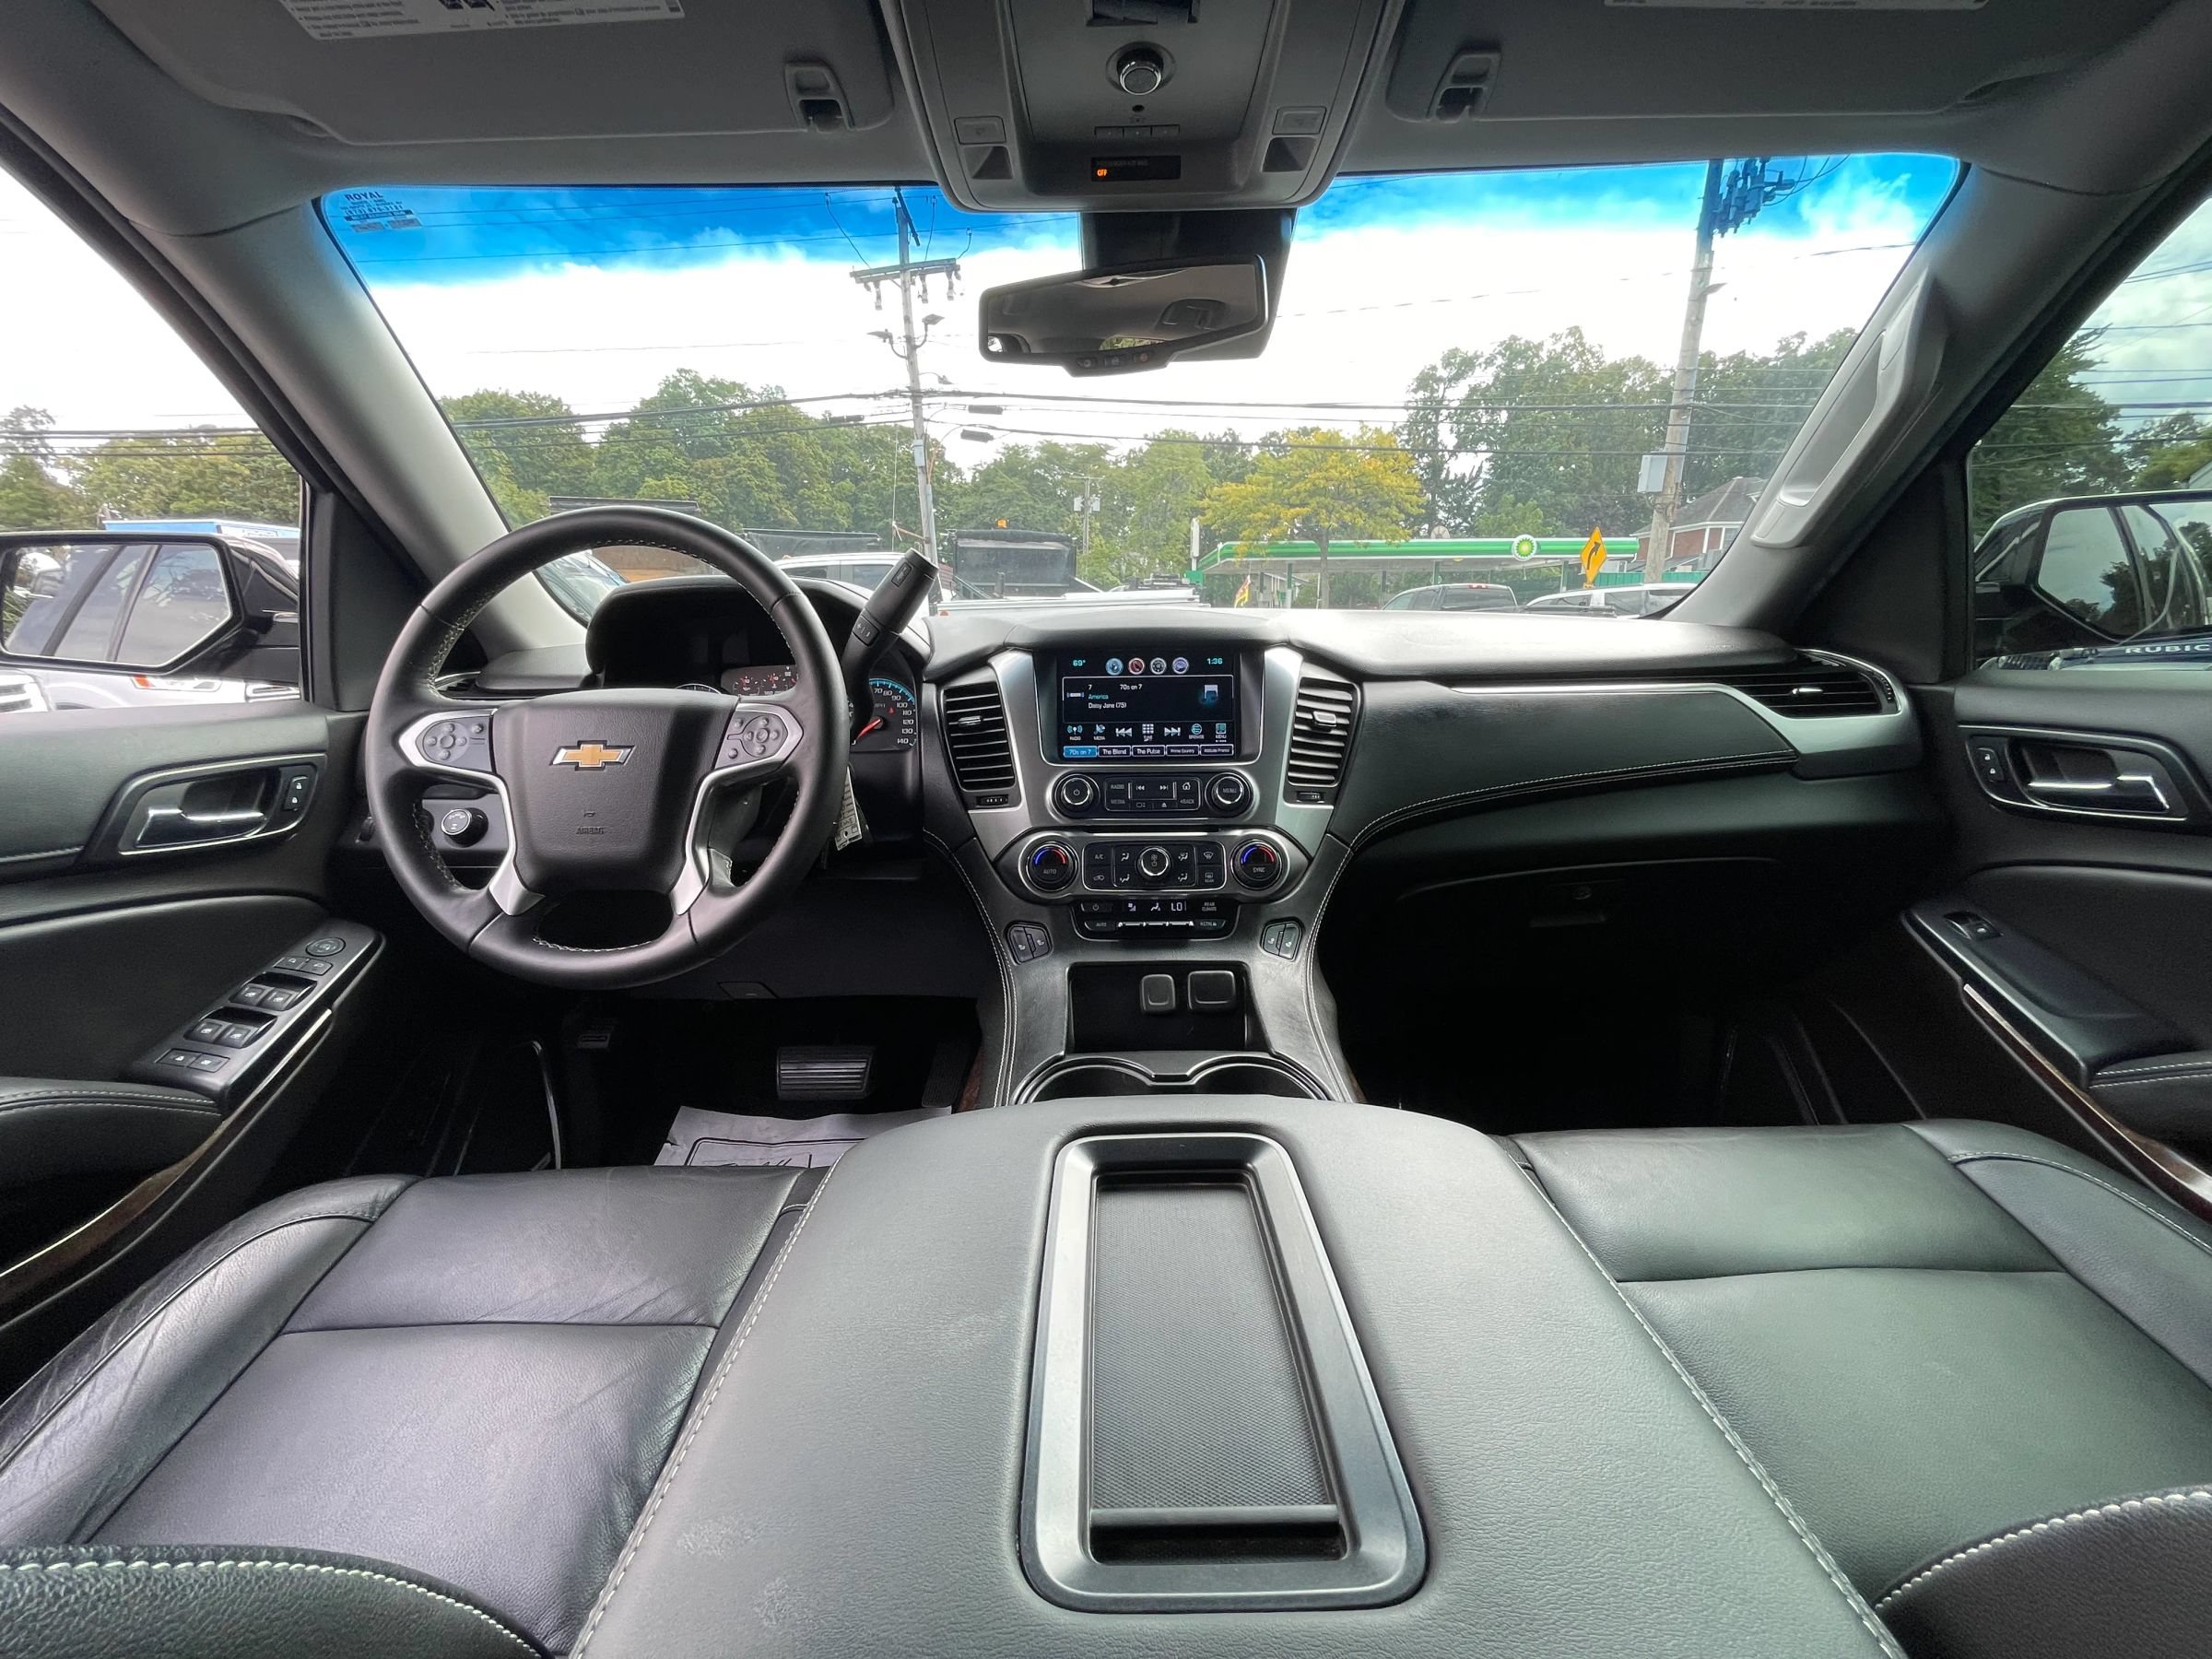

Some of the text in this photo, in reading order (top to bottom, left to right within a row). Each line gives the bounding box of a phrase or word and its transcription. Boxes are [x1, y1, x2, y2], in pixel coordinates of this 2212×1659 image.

[345, 191, 383, 201] ROYAL
[2124, 643, 2211, 654] RUBIC
[1206, 657, 1223, 665] 1:36
